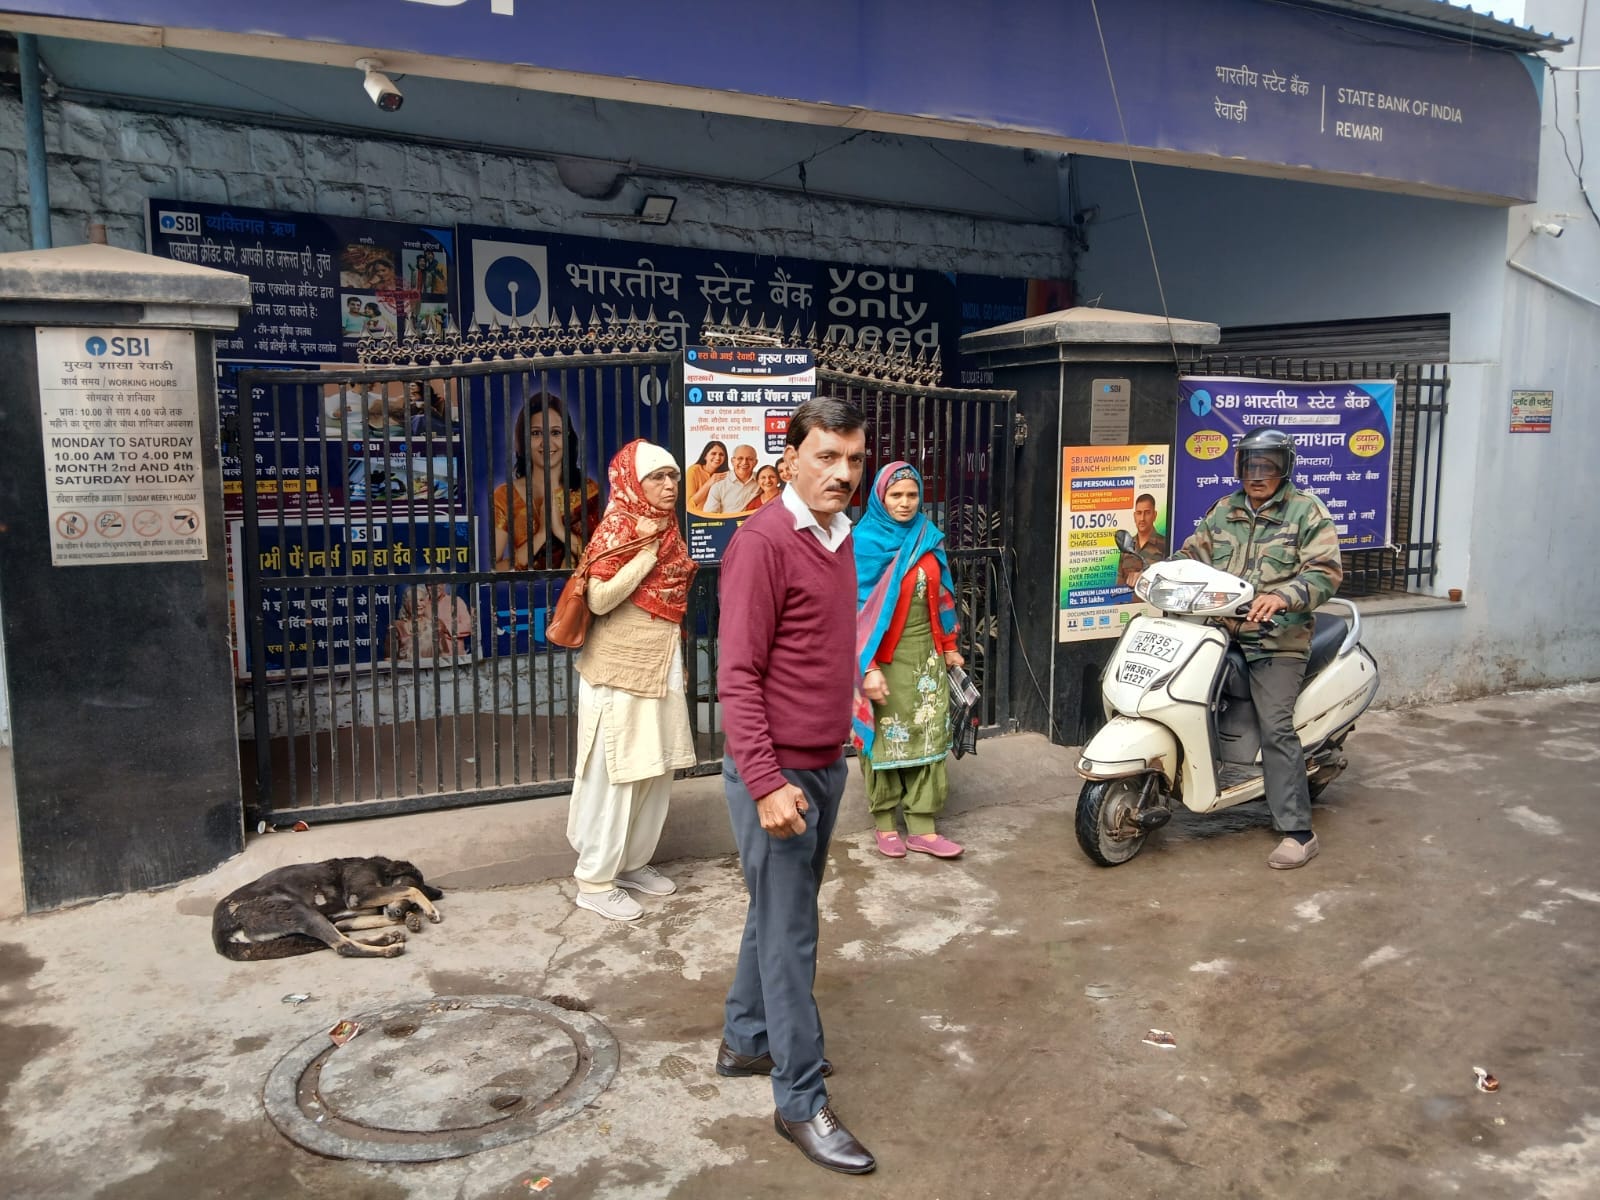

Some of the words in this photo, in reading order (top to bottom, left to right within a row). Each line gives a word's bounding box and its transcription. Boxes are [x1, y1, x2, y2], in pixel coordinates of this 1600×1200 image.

[1215, 64, 1258, 88] भारतीय
[1262, 70, 1287, 93] स्टेट
[1290, 74, 1310, 97] बैंक
[1337, 87, 1375, 108] STATE
[1378, 94, 1410, 114] BANK
[1412, 101, 1429, 116] OF
[1431, 103, 1463, 123] INDIA
[1336, 121, 1383, 141] REWARI
[175, 215, 199, 232] SBI
[240, 240, 263, 267] आपकी
[265, 248, 275, 269] हर
[565, 258, 682, 301] भारतीय
[696, 262, 755, 305] स्टेट
[768, 266, 813, 310] बैंक
[828, 267, 914, 294] you
[828, 293, 928, 326] only
[828, 322, 939, 348] need
[111, 336, 150, 357] SBI
[757, 353, 783, 366] मुख्य
[784, 353, 808, 364] शाखा
[62, 360, 92, 373] मुख्य
[98, 361, 133, 370] शाखा
[80, 378, 100, 386] समय
[108, 379, 148, 387] WORKING
[149, 379, 177, 387] HOURS
[706, 391, 724, 402] एस
[726, 388, 739, 402] बी
[740, 388, 763, 403] आई
[764, 388, 790, 403] पेंशन
[1215, 394, 1240, 409] SBI
[1244, 389, 1299, 409] भारतीय
[1307, 390, 1336, 409] स्टेट
[1344, 390, 1371, 409] बैंक
[81, 408, 103, 417] 10.00
[134, 408, 151, 417] 4.00
[1242, 414, 1277, 426] शाखा
[51, 437, 105, 449] MONDAY
[108, 437, 126, 448] TO
[129, 437, 194, 448] SATURDAY
[1290, 432, 1347, 447] माधान
[362, 443, 380, 452] BI
[54, 452, 90, 461] 10.00
[93, 452, 115, 461] AM
[119, 451, 138, 460] TO
[142, 451, 169, 460] 4.00
[173, 451, 193, 460] PM
[966, 451, 986, 473] YOO
[1071, 456, 1083, 464] SBI
[1084, 456, 1111, 464] REWARI
[1112, 455, 1130, 463] MAIN
[1148, 454, 1164, 466] SBI
[55, 463, 107, 473] MONTH
[111, 463, 136, 472] 2nd
[139, 463, 169, 472] AND
[173, 463, 194, 471] 4th
[1071, 465, 1100, 473] BRANCH
[55, 475, 132, 485] SATURDAY
[135, 474, 195, 484] HOLIDAY
[1083, 480, 1116, 488] PERSONAL
[1117, 479, 1134, 487] LOAN
[1196, 473, 1219, 488] पुराने
[1313, 470, 1342, 482] भारतीय
[1346, 470, 1361, 481] स्टेट
[1365, 470, 1380, 480] बैंक
[1070, 513, 1118, 529] 10.50%
[359, 528, 378, 540] SI
[1070, 539, 1098, 548] CHARGES
[1070, 549, 1098, 557] IMMEDIATE
[1070, 589, 1096, 597] MAXIMUM
[1143, 633, 1172, 647] HR36
[1135, 642, 1171, 658] R4127
[1125, 663, 1154, 678] HR36R
[1123, 673, 1145, 684] 4127
